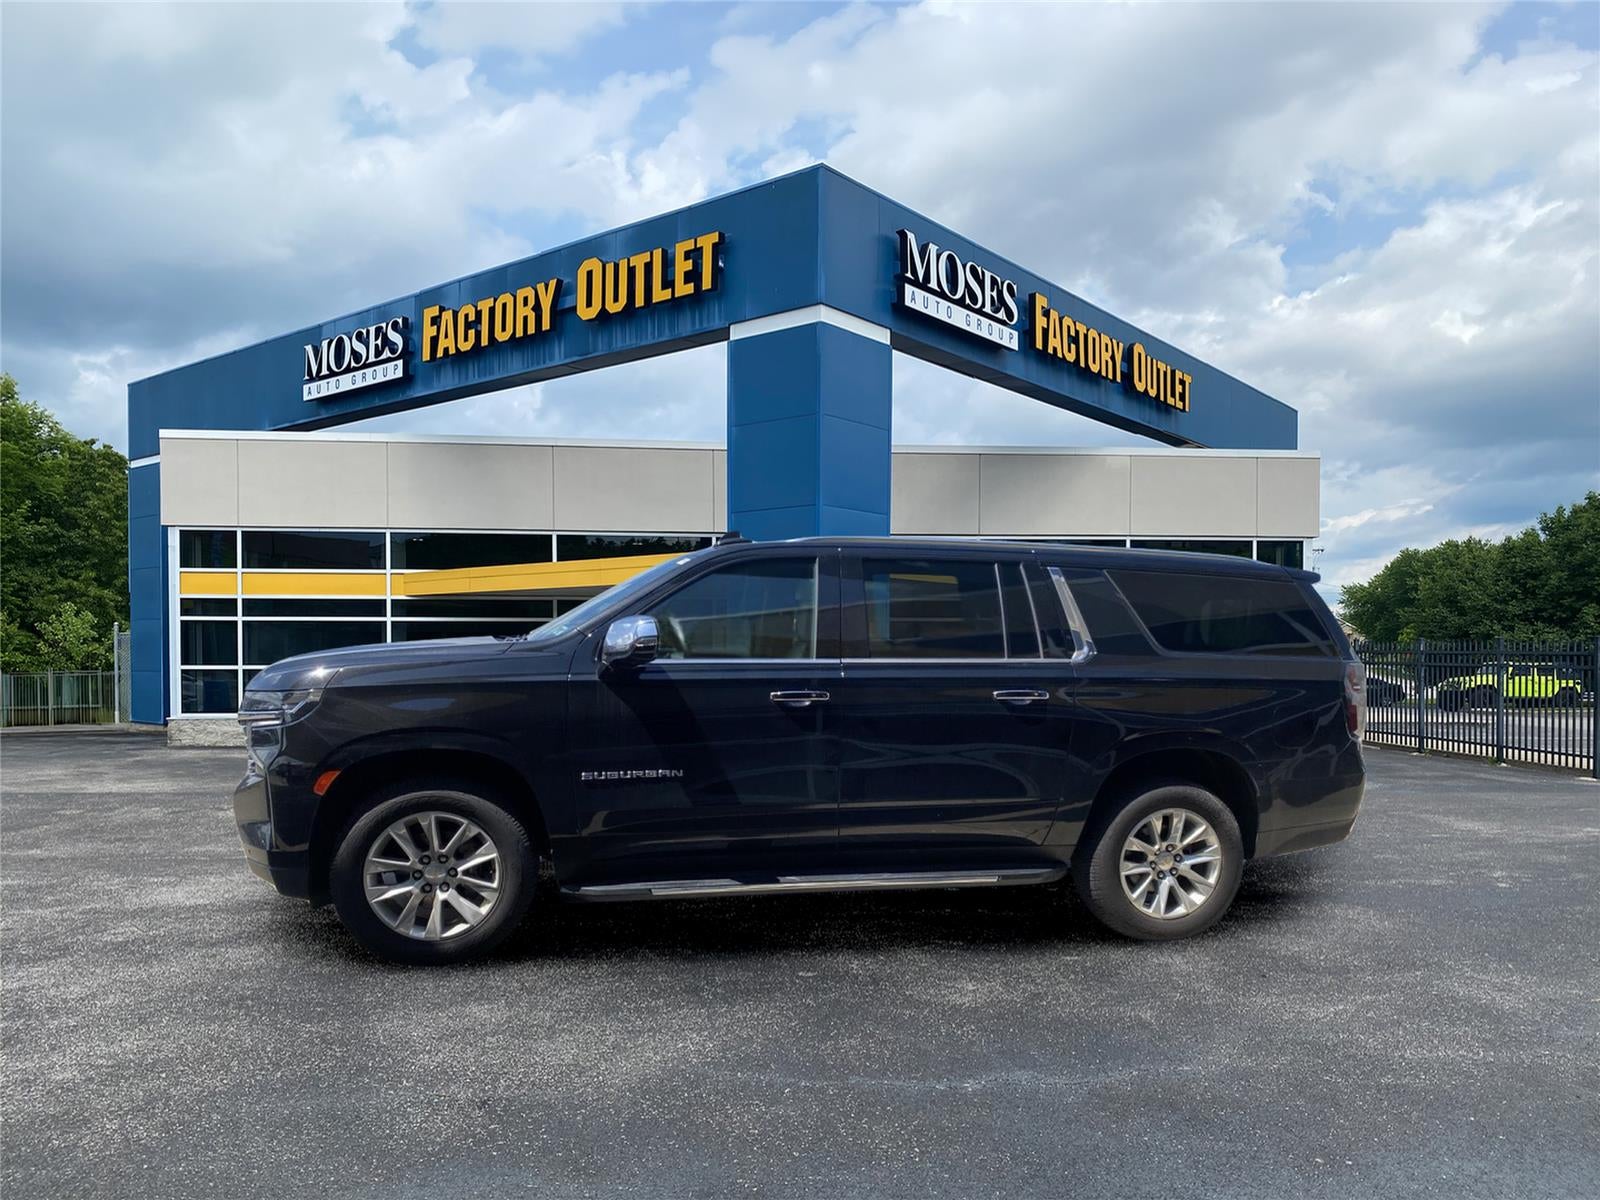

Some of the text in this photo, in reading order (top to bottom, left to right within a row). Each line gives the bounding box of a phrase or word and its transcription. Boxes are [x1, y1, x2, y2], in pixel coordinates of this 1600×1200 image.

[422, 231, 720, 362] FACTORY OUTLET
[904, 229, 1018, 325] MOSES
[303, 316, 404, 380] MOSES
[910, 290, 1015, 344] AUTO GROUP
[307, 364, 400, 397] AUTO GROUP
[1035, 292, 1192, 413] FACTORY OUTLET
[581, 769, 684, 780] SUBURBAN
